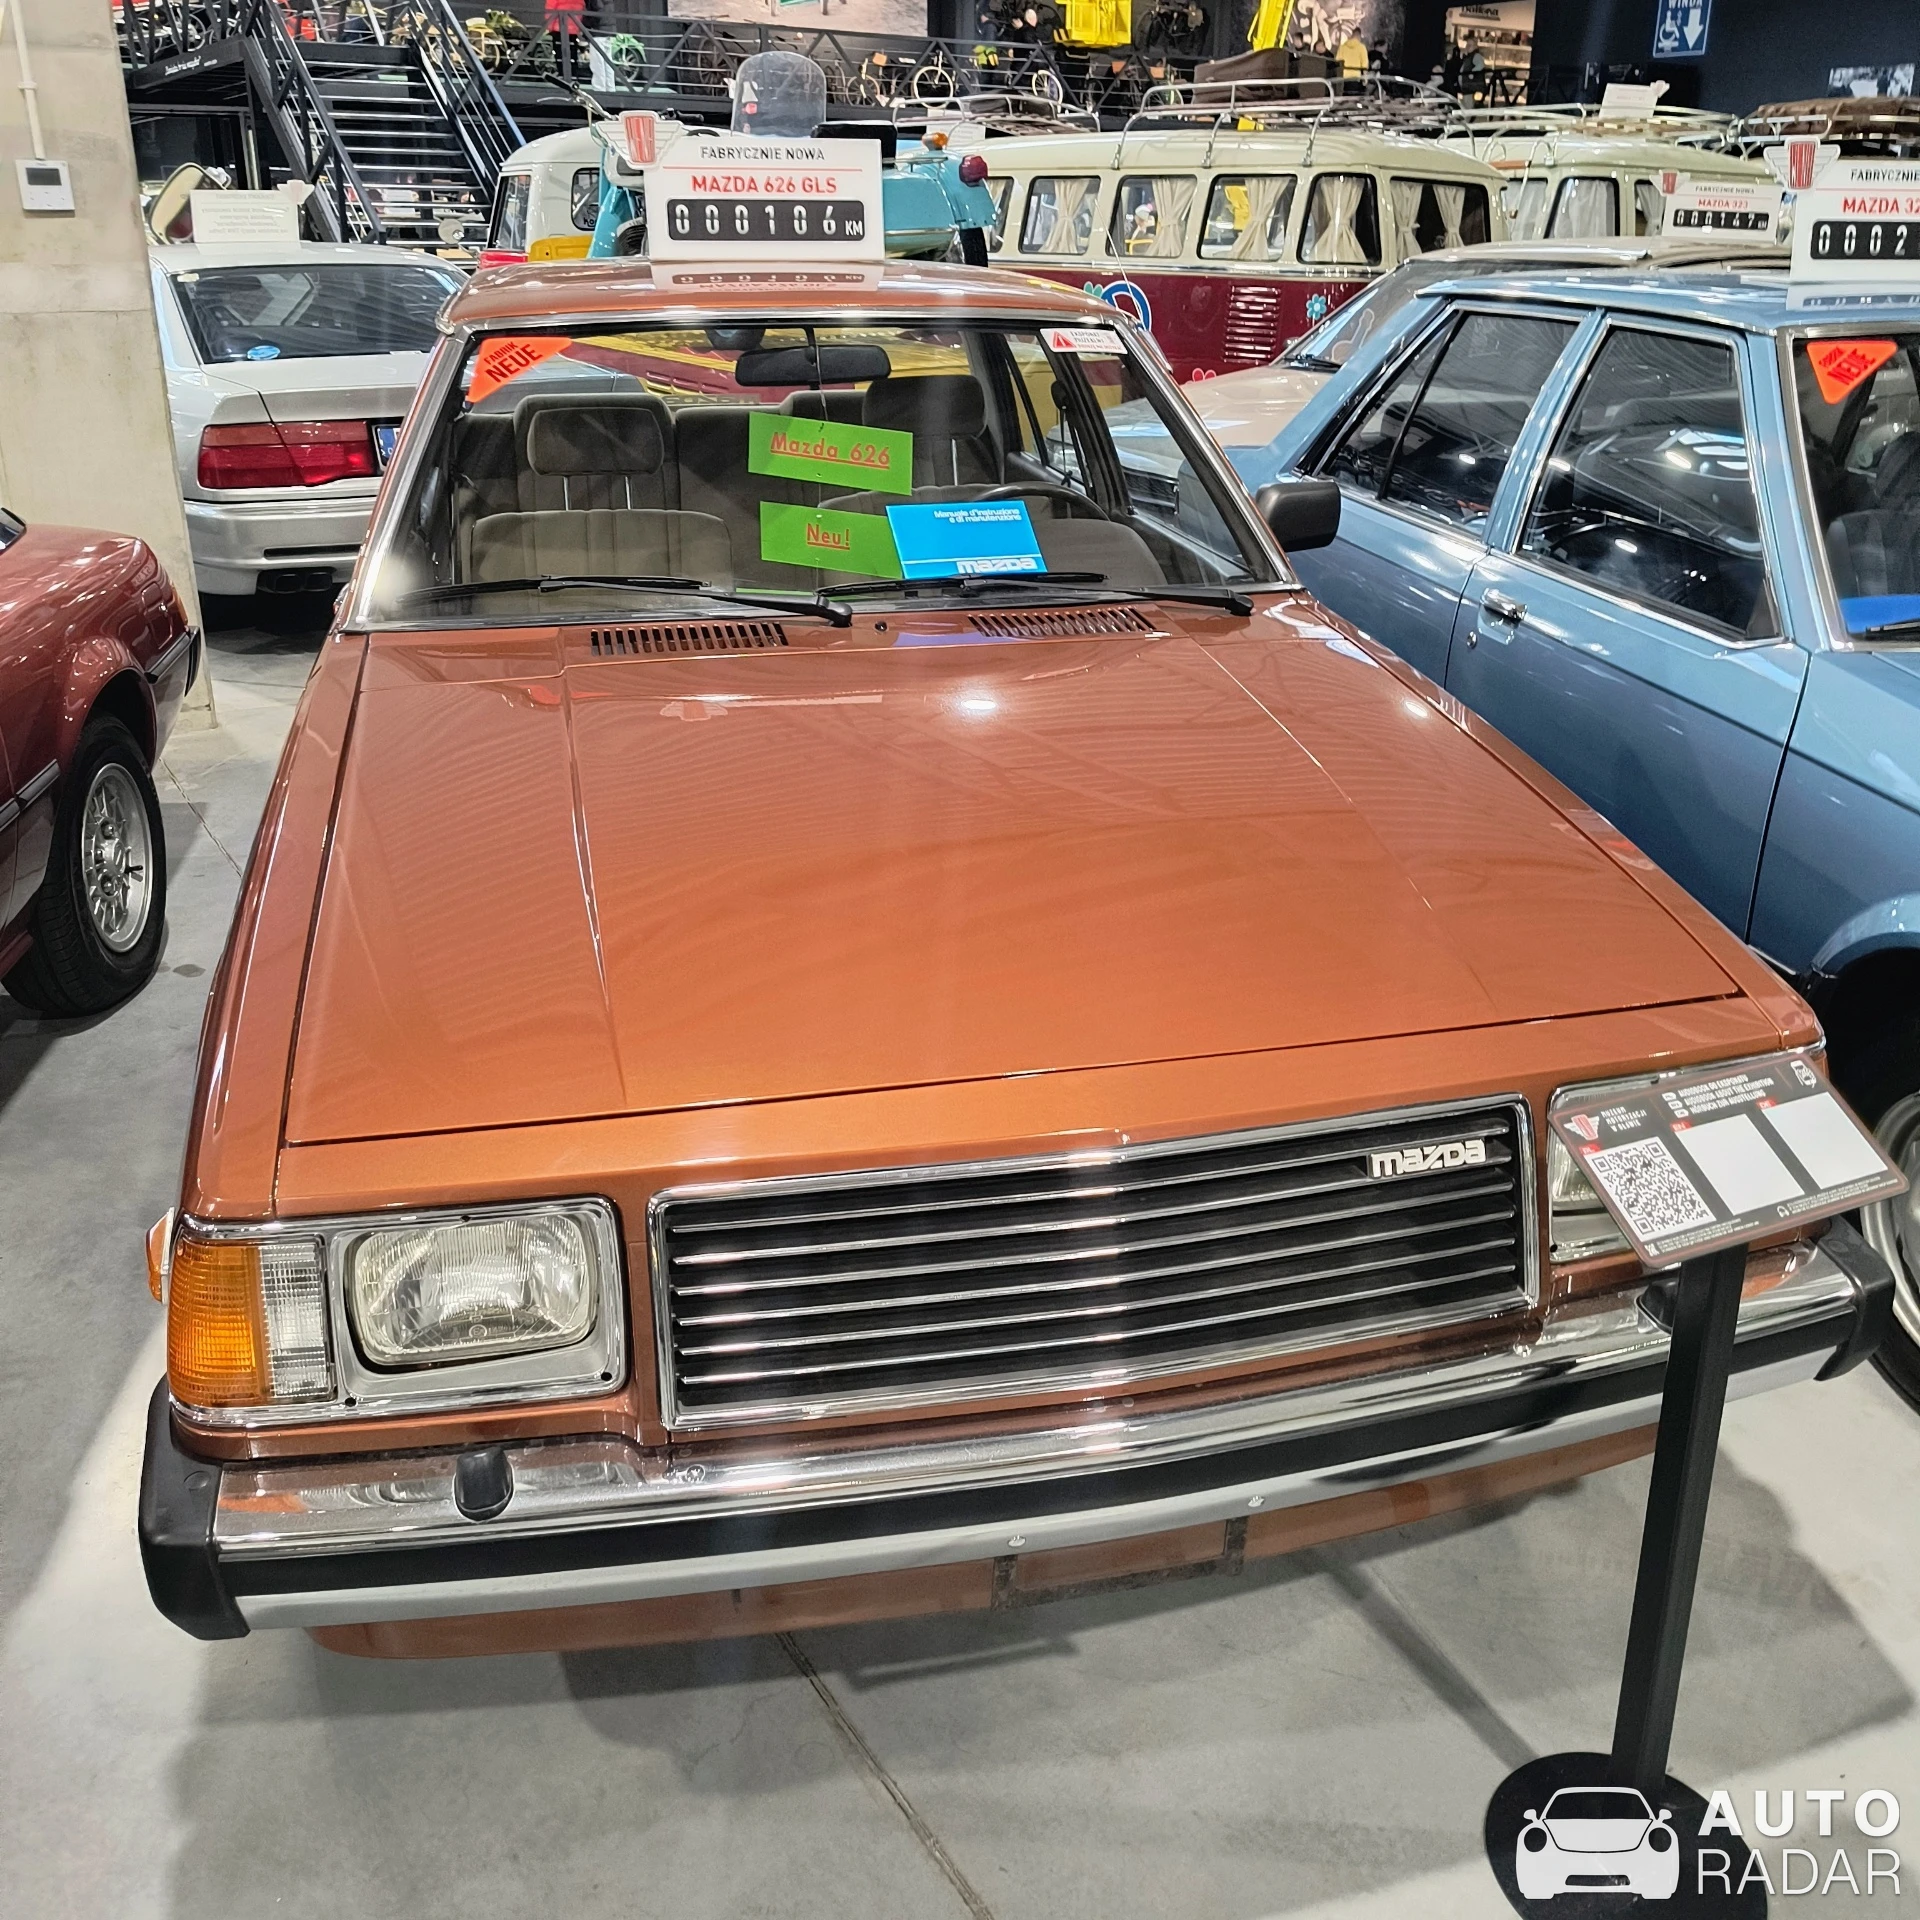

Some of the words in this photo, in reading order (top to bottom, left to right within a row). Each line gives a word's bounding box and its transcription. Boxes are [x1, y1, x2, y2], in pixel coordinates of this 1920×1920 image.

[700, 146, 782, 160] FABRYCZNIE
[786, 147, 825, 160] NOWA
[691, 175, 759, 193] MAZDA
[764, 176, 796, 193] 626
[802, 176, 837, 193] GLS
[1851, 168, 1920, 182] FABRYCZNIE
[1698, 199, 1730, 209] MAZDA
[1842, 196, 1900, 214] MAZDA
[845, 220, 863, 236] KM
[484, 341, 519, 365] FABRIK
[484, 343, 543, 383] NEUE
[771, 431, 838, 459] Mazda
[851, 443, 890, 465] 626
[807, 523, 850, 547] Neu!
[956, 557, 1038, 574] mazda
[1370, 1139, 1487, 1178] mazda
